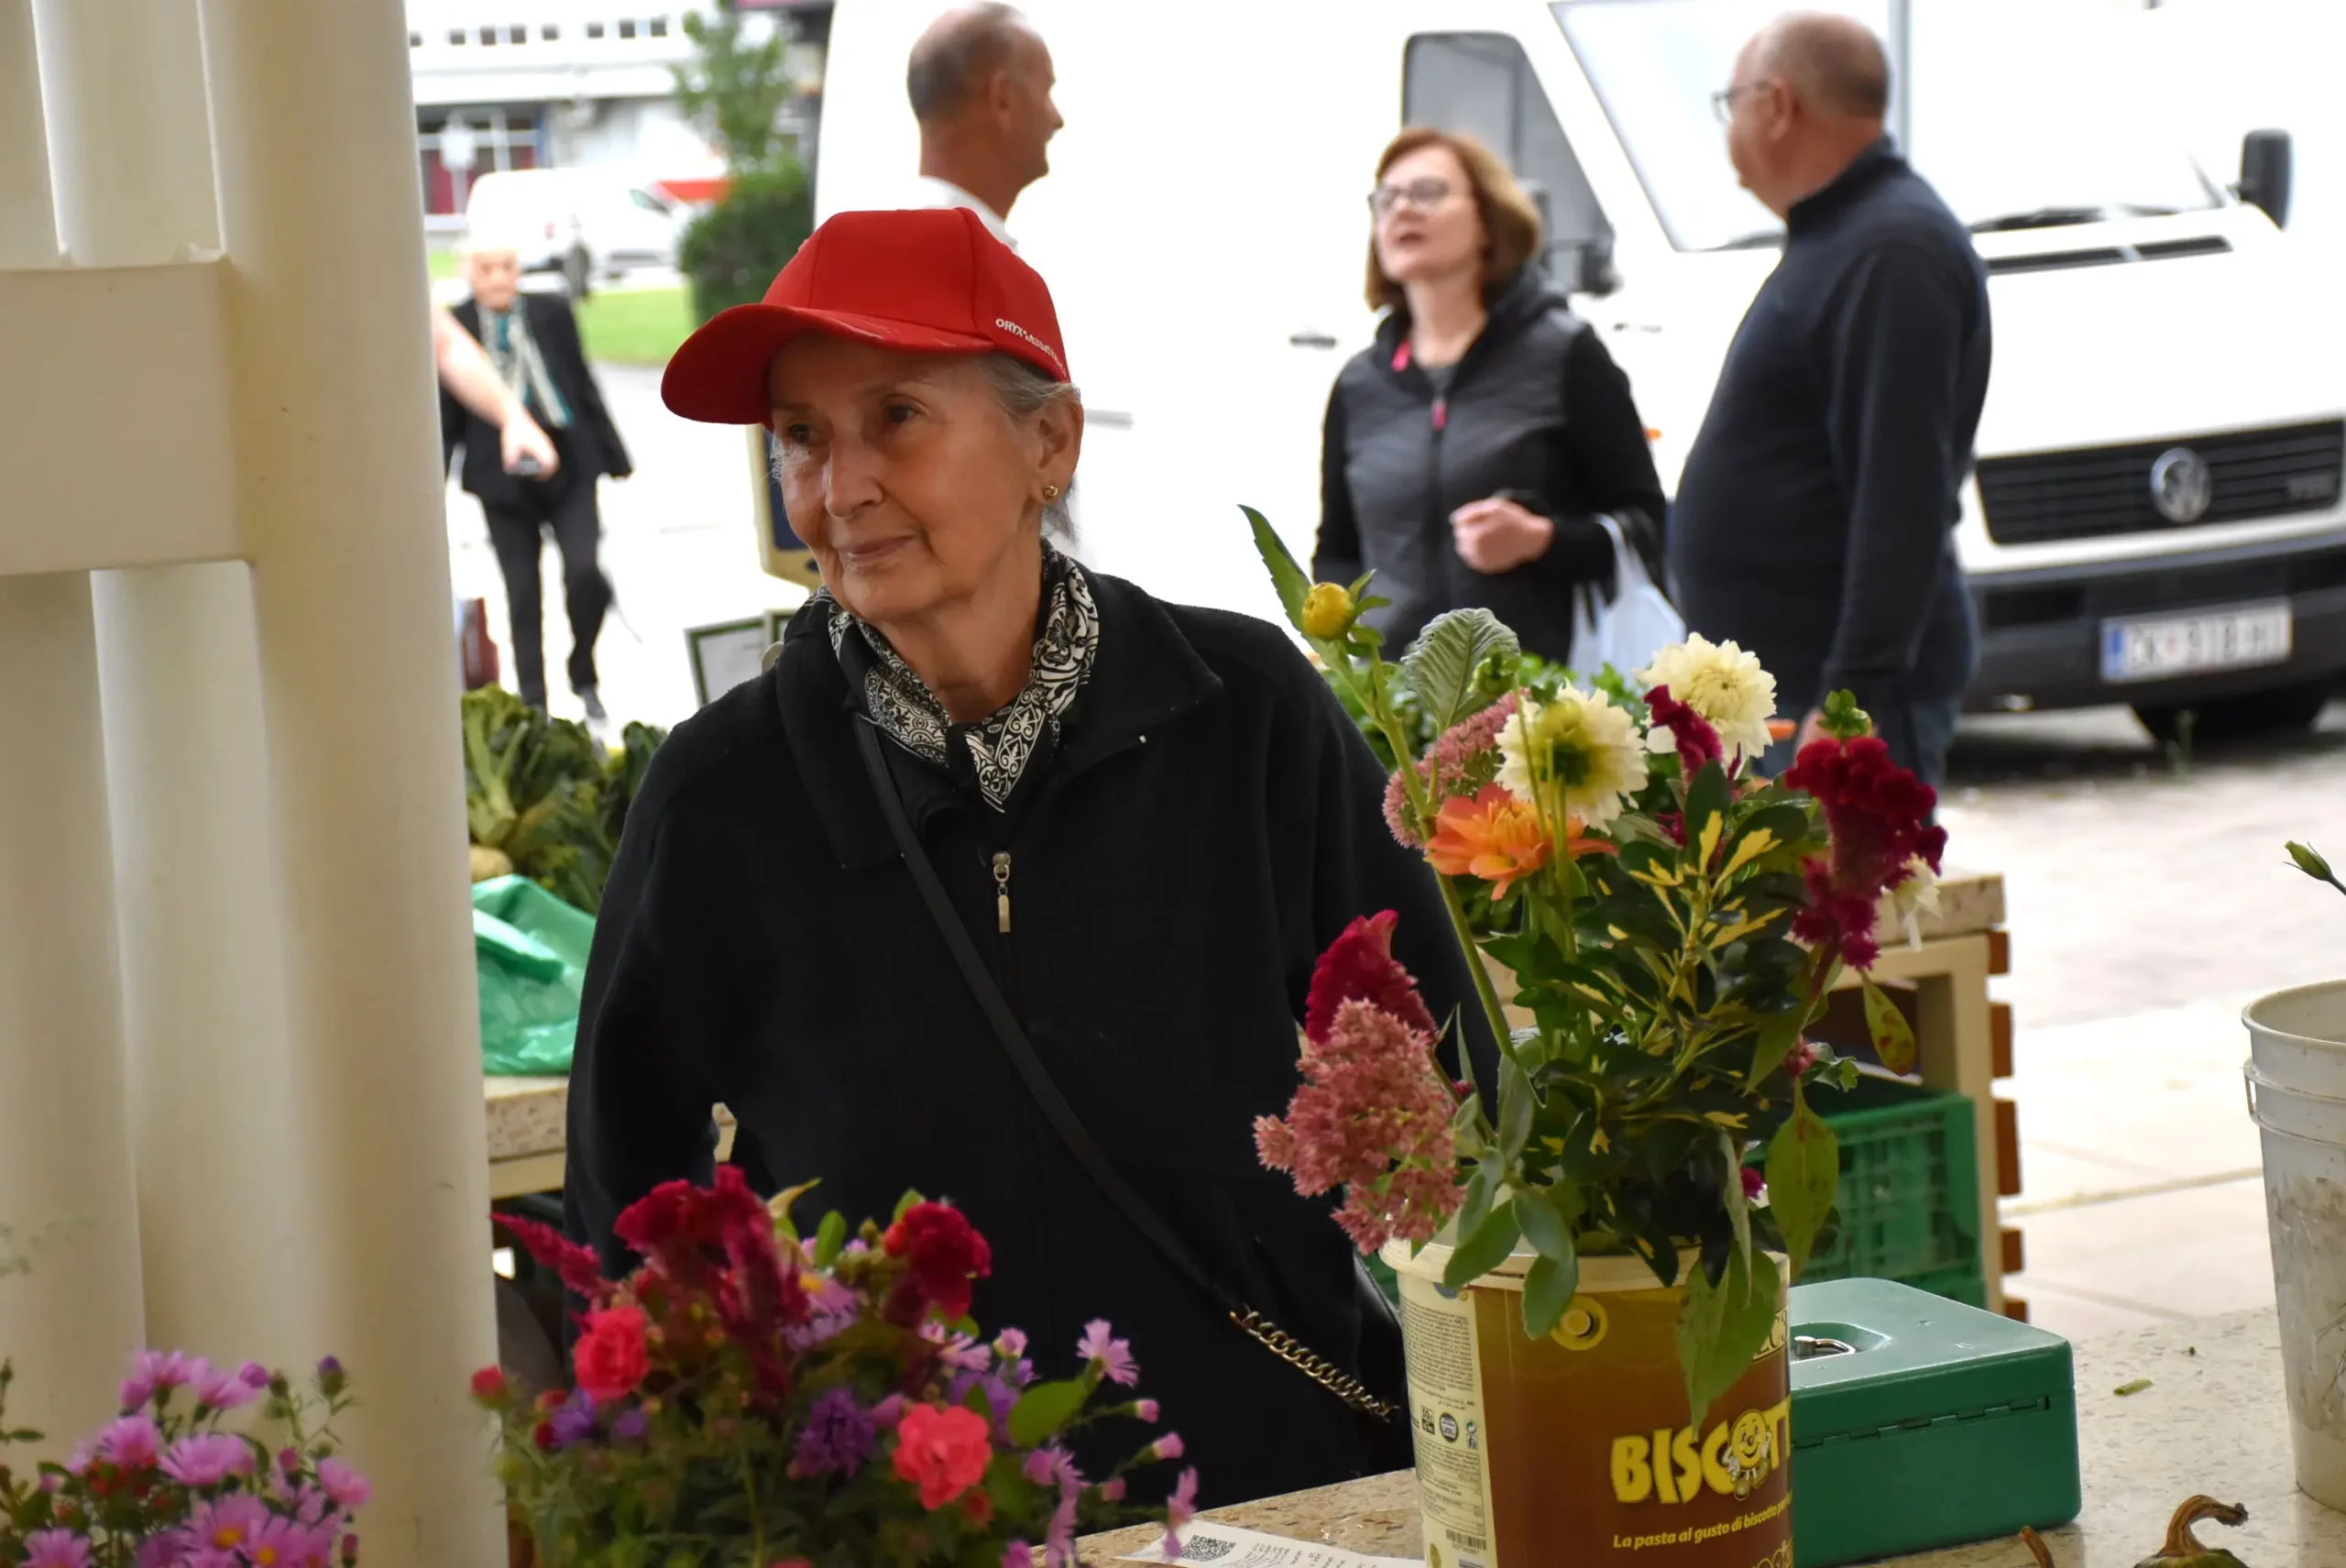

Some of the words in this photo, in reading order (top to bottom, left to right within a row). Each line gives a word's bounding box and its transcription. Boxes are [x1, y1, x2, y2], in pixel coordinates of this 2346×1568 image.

[995, 318, 1024, 338] ORYX
[1613, 1534, 1632, 1549] La
[1634, 1530, 1676, 1550] pasta
[1678, 1527, 1692, 1543] al
[1694, 1522, 1730, 1544] gusto
[1731, 1516, 1743, 1532] di
[1743, 1506, 1778, 1529] biscotto
